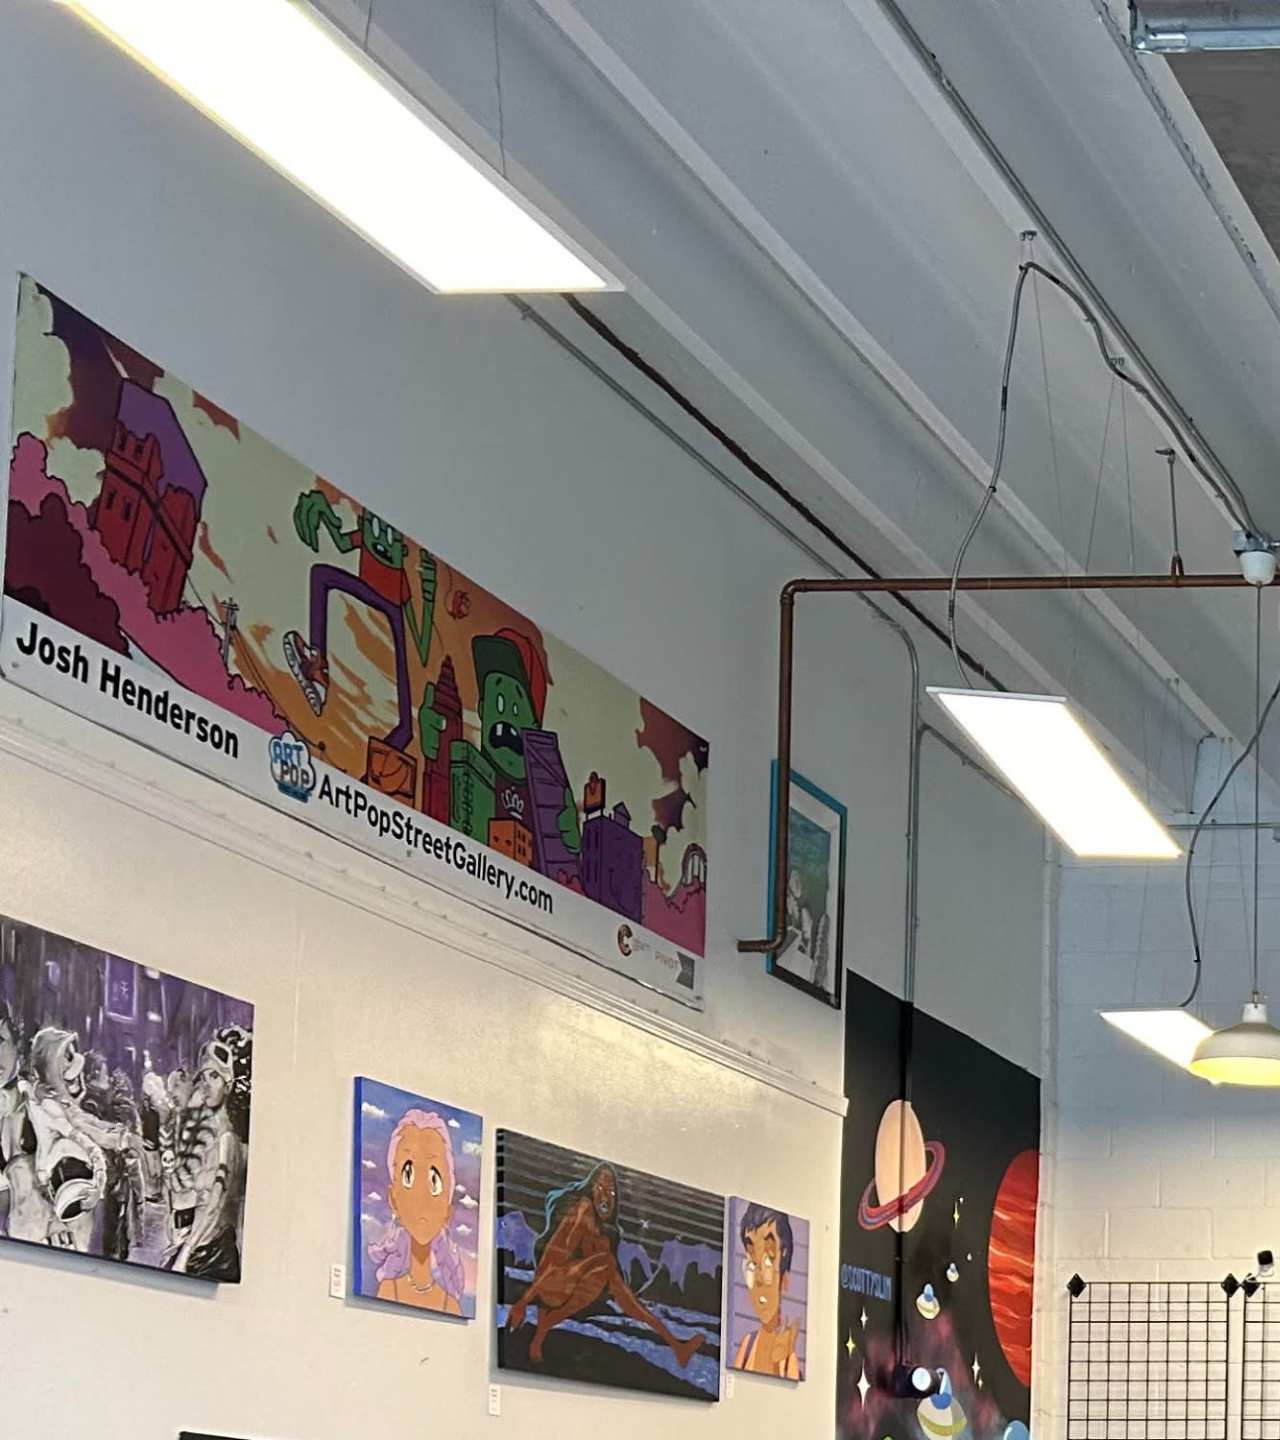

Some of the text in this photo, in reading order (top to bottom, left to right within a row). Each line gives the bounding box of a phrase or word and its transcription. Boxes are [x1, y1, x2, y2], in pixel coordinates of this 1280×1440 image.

[16, 622, 239, 759] Josh Henderson
[273, 741, 304, 767] ART
[281, 760, 310, 789] POP
[318, 774, 553, 914] ArtPopStreetGallery.com
